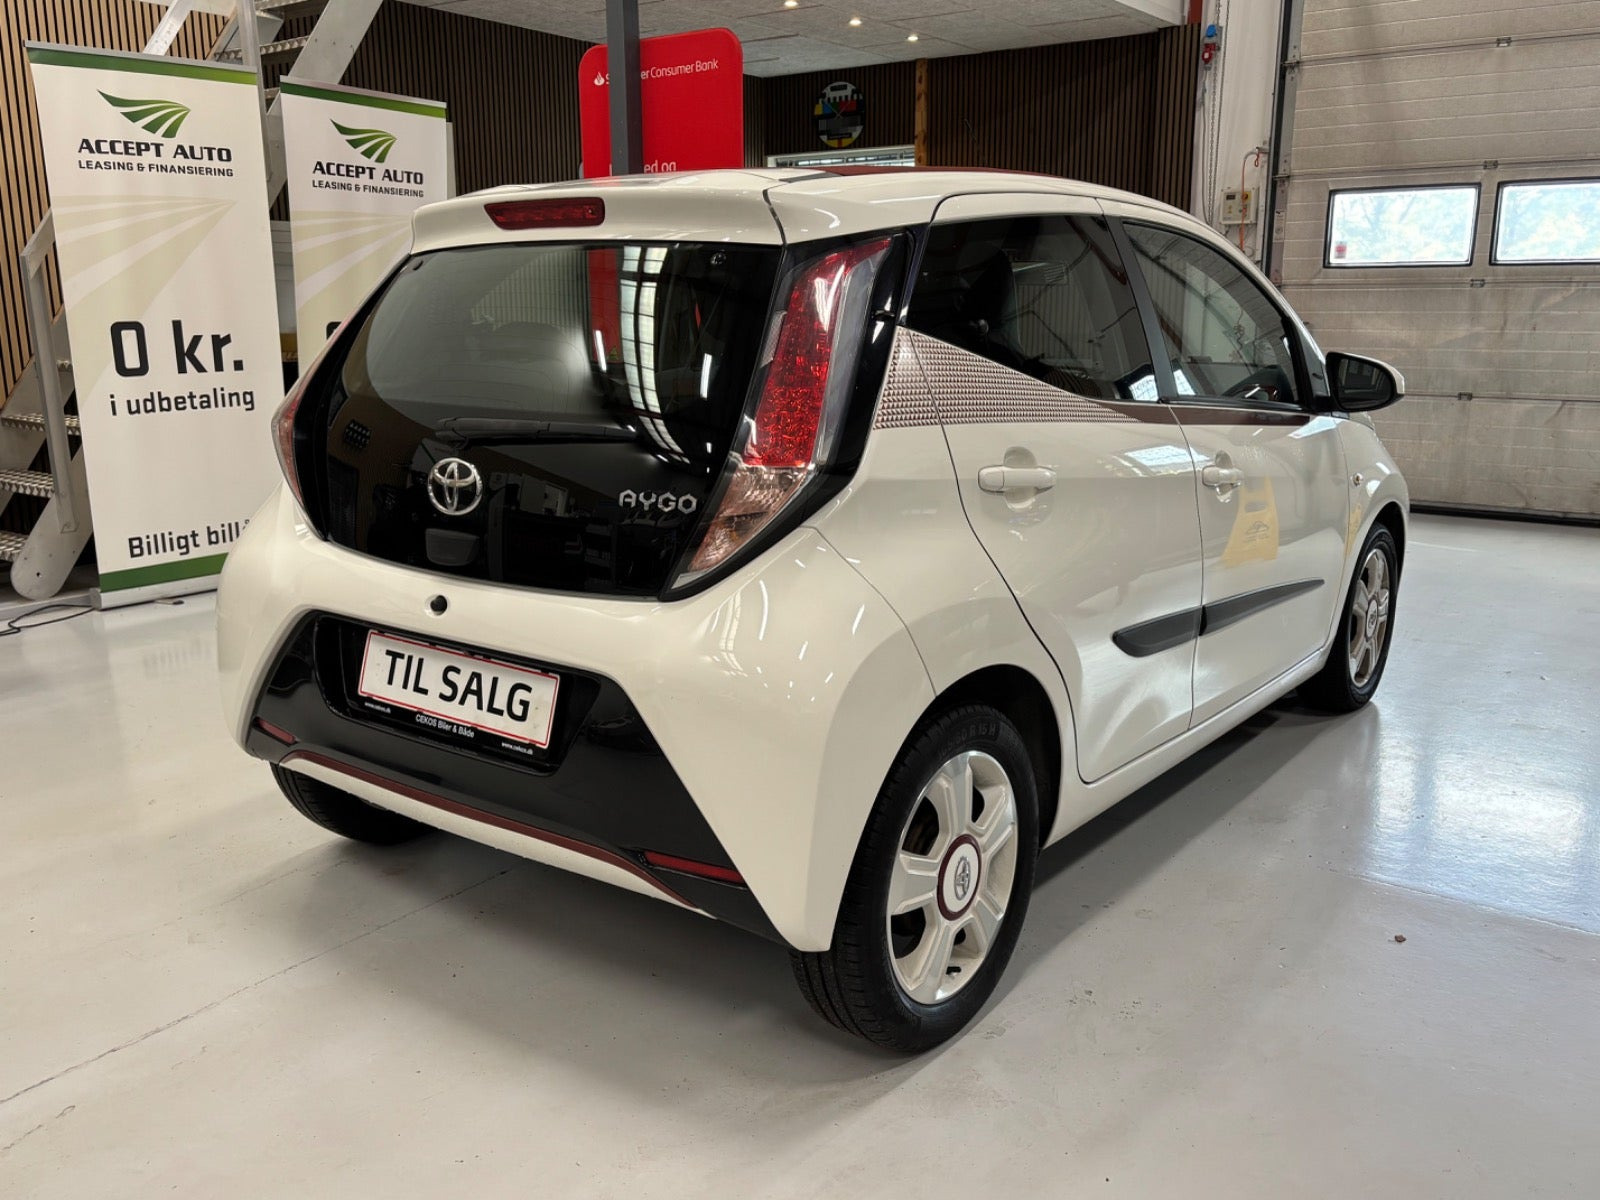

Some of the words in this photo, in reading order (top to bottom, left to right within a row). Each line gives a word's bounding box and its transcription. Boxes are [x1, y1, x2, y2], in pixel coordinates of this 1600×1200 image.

[650, 63, 695, 79] Consumer
[695, 58, 719, 72] Bank
[78, 138, 164, 158] ACCEPT
[173, 144, 232, 162] AUTO
[78, 160, 133, 171] LEASING
[137, 163, 145, 172] &
[148, 164, 234, 177] FINANSIERING
[312, 160, 376, 180] ACCEPT
[381, 169, 424, 185] AUTO
[312, 179, 352, 191] LEASING
[354, 184, 361, 192] &
[363, 184, 424, 198] FINANSIERING
[171, 320, 244, 374] kr.
[109, 393, 118, 416] i
[126, 387, 255, 416] udbetaling
[618, 489, 698, 514] AYGO
[128, 529, 200, 558] Billigt
[385, 649, 429, 696] TIL
[438, 665, 533, 723] SALG
[452, 724, 458, 734] &
